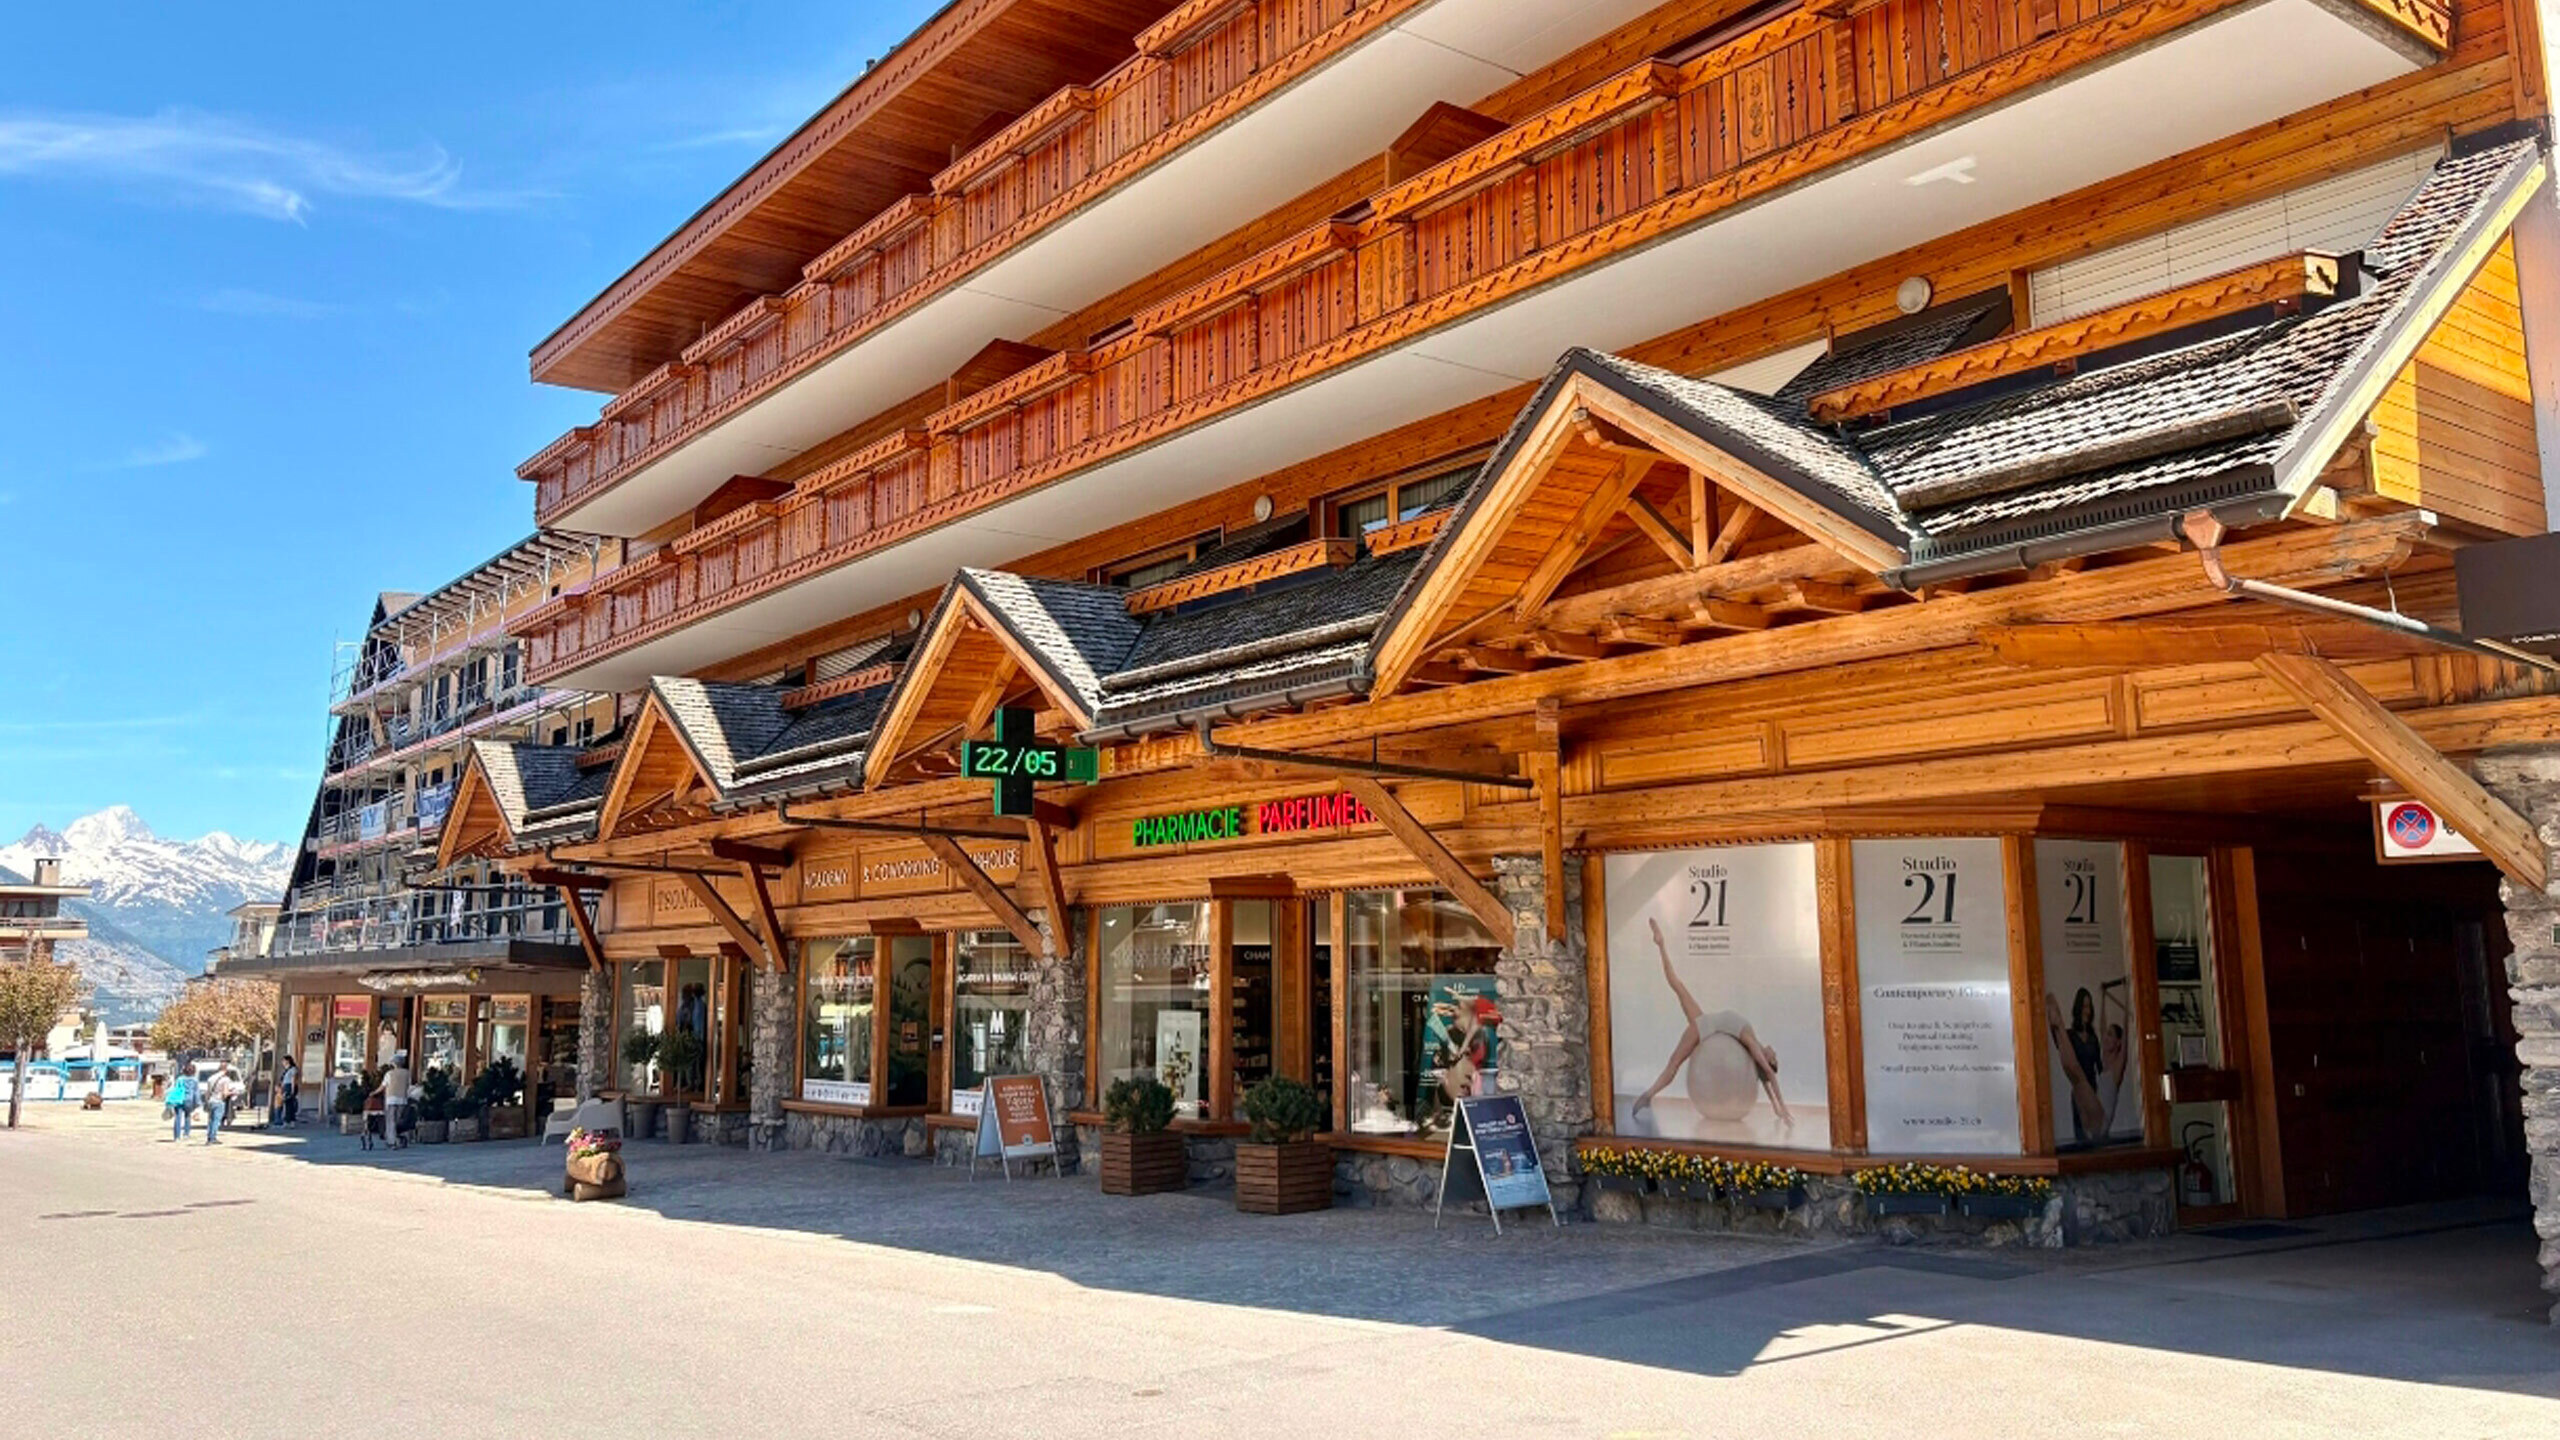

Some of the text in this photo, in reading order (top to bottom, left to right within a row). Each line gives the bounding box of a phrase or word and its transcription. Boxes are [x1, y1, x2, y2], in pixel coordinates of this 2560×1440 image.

[975, 747, 1056, 776] 22/05
[1133, 807, 1240, 848] PHARMACIE
[863, 866, 872, 883] &
[1688, 864, 1728, 878] Studio
[1903, 856, 1957, 870] Studio
[1688, 879, 1730, 928] 21
[1901, 873, 1960, 924] 21
[2064, 873, 2099, 924] 21
[1873, 986, 1955, 1000] Contemporary
